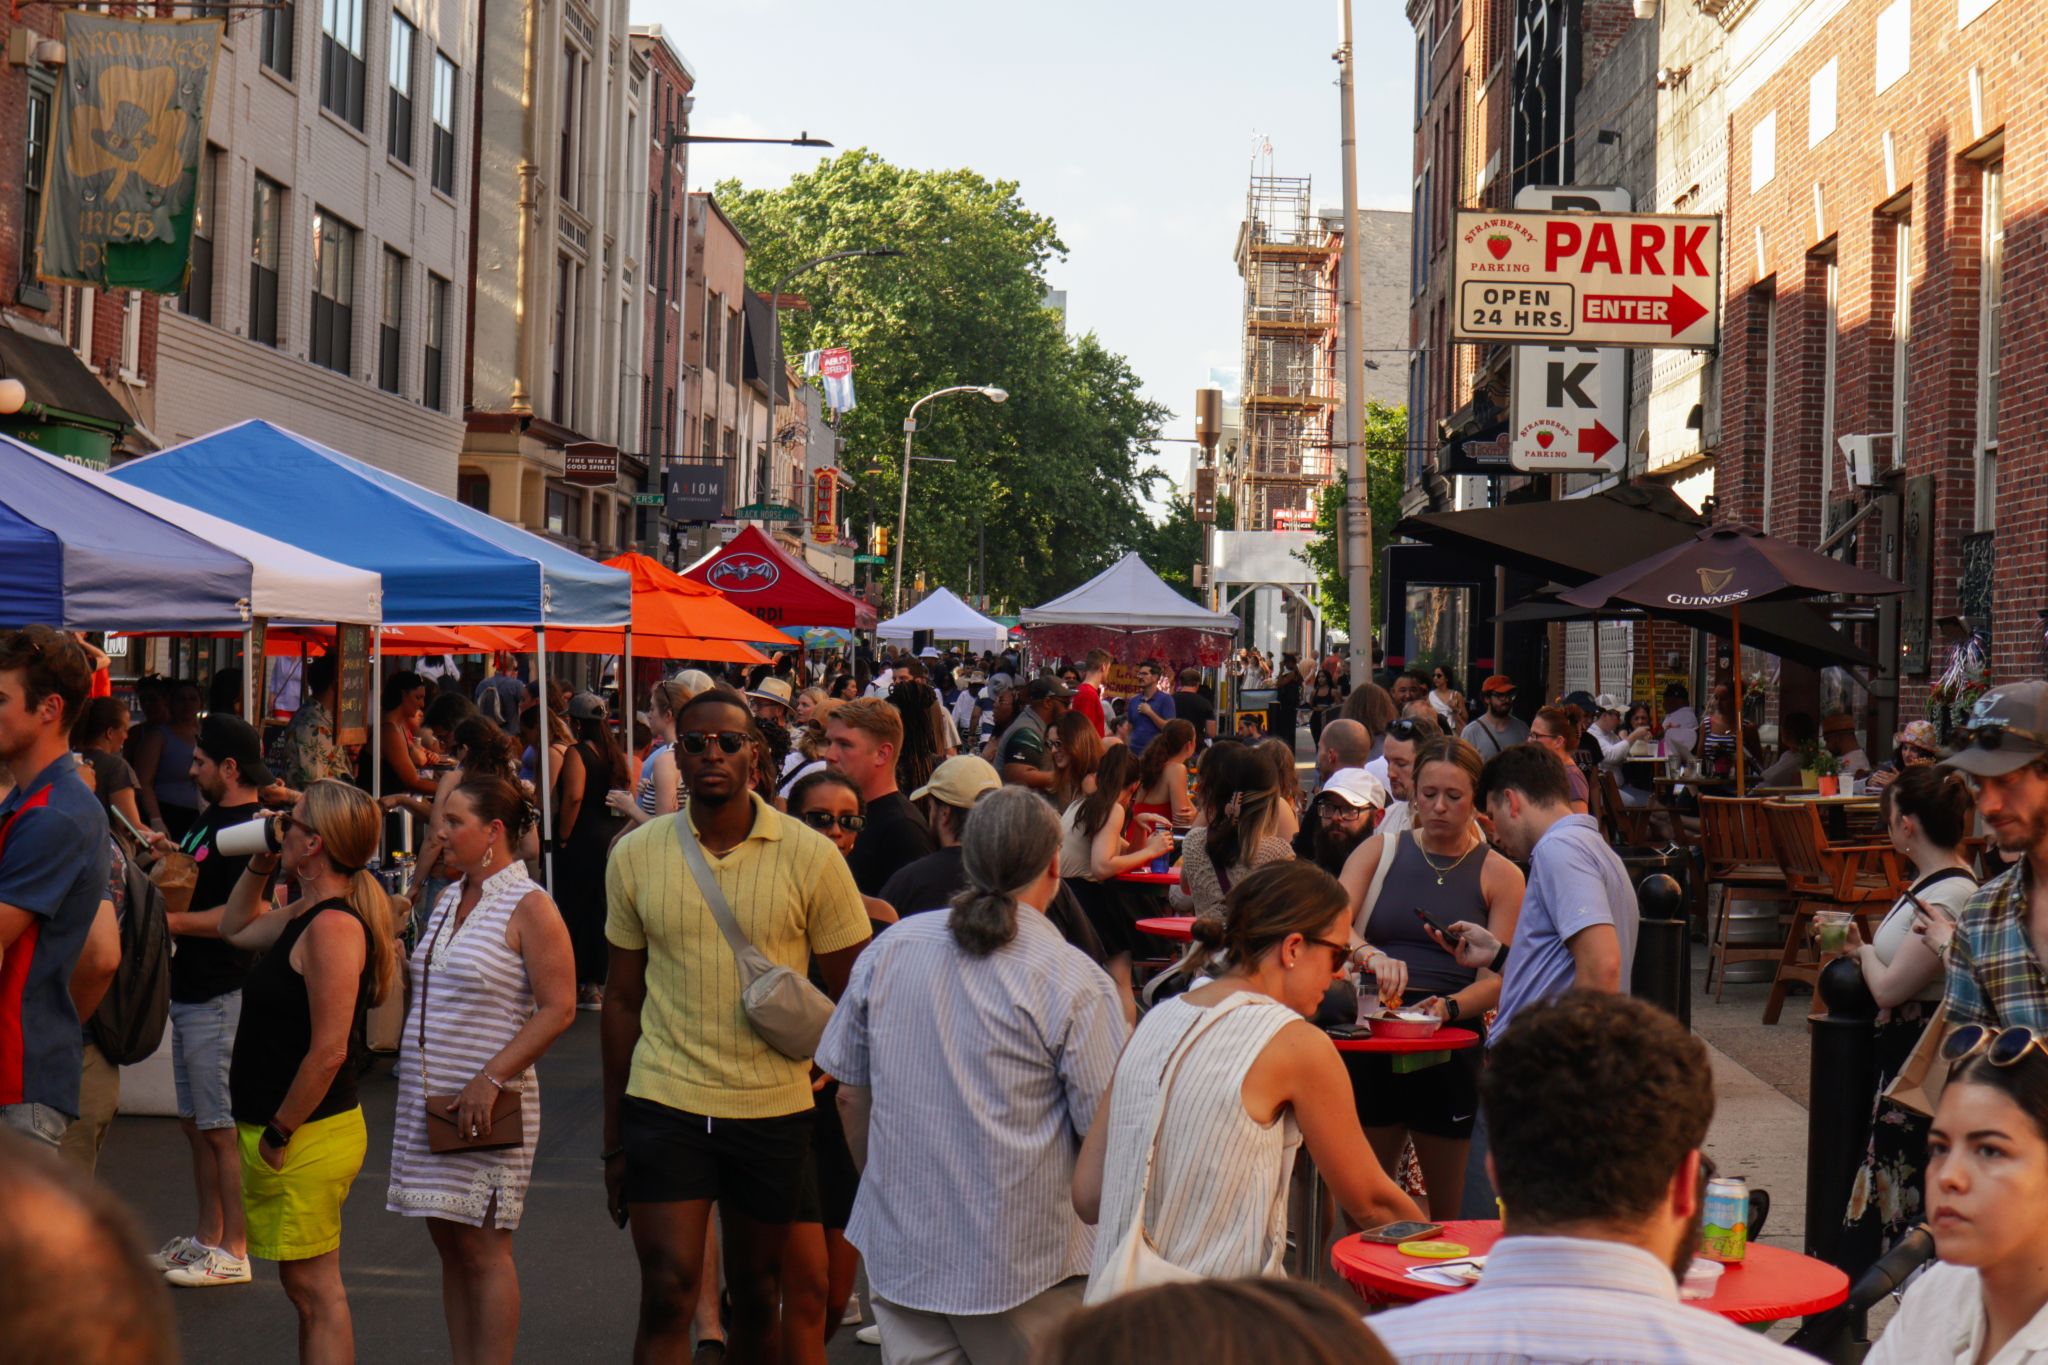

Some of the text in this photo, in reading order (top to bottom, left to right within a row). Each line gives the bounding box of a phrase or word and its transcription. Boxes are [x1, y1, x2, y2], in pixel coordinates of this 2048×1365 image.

[80, 210, 155, 240] IRISH
[1464, 218, 1538, 244] STRAWBERRY
[1545, 221, 1711, 277] PARK
[1471, 262, 1531, 273] PARKING
[1483, 288, 1551, 307] OPEN
[1473, 308, 1569, 328] 24 HRS.
[1586, 299, 1669, 321] ENTER
[1520, 419, 1573, 438] STRAWBERRY
[1525, 450, 1568, 458] PARKING
[736, 509, 758, 520] BLACK
[760, 509, 782, 520] HORSE
[1666, 588, 1749, 606] GUINNESS
